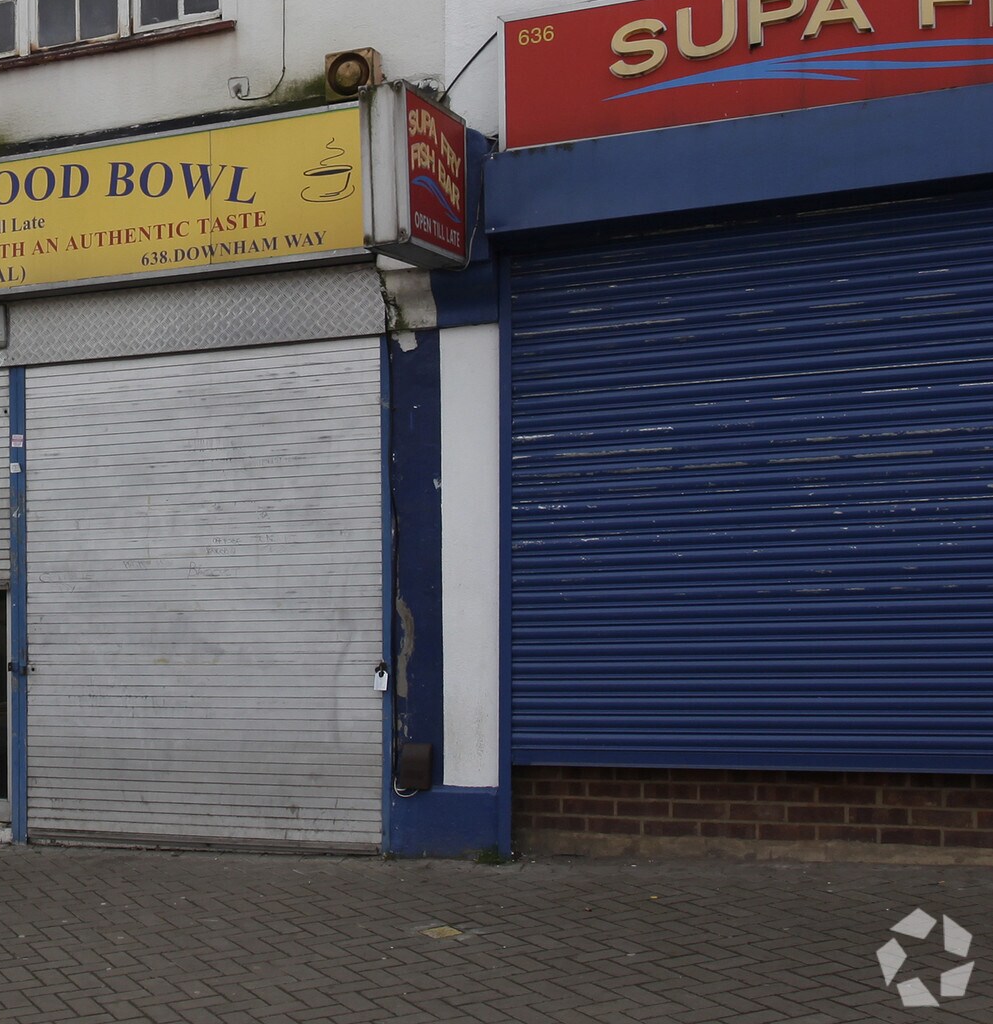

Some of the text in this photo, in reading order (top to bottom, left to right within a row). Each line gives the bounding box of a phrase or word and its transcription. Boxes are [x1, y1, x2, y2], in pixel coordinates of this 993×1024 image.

[517, 25, 555, 46] 636
[408, 108, 462, 178] SUPA FRY
[105, 161, 256, 204] BOWL
[411, 142, 461, 211] FISH BAR
[12, 216, 45, 232] Late
[32, 237, 59, 256] AN
[65, 220, 190, 251] AUTHENTIC
[196, 210, 267, 233] TASTE
[284, 231, 327, 248] WAY
[414, 210, 461, 248] OPEN TILL LATE
